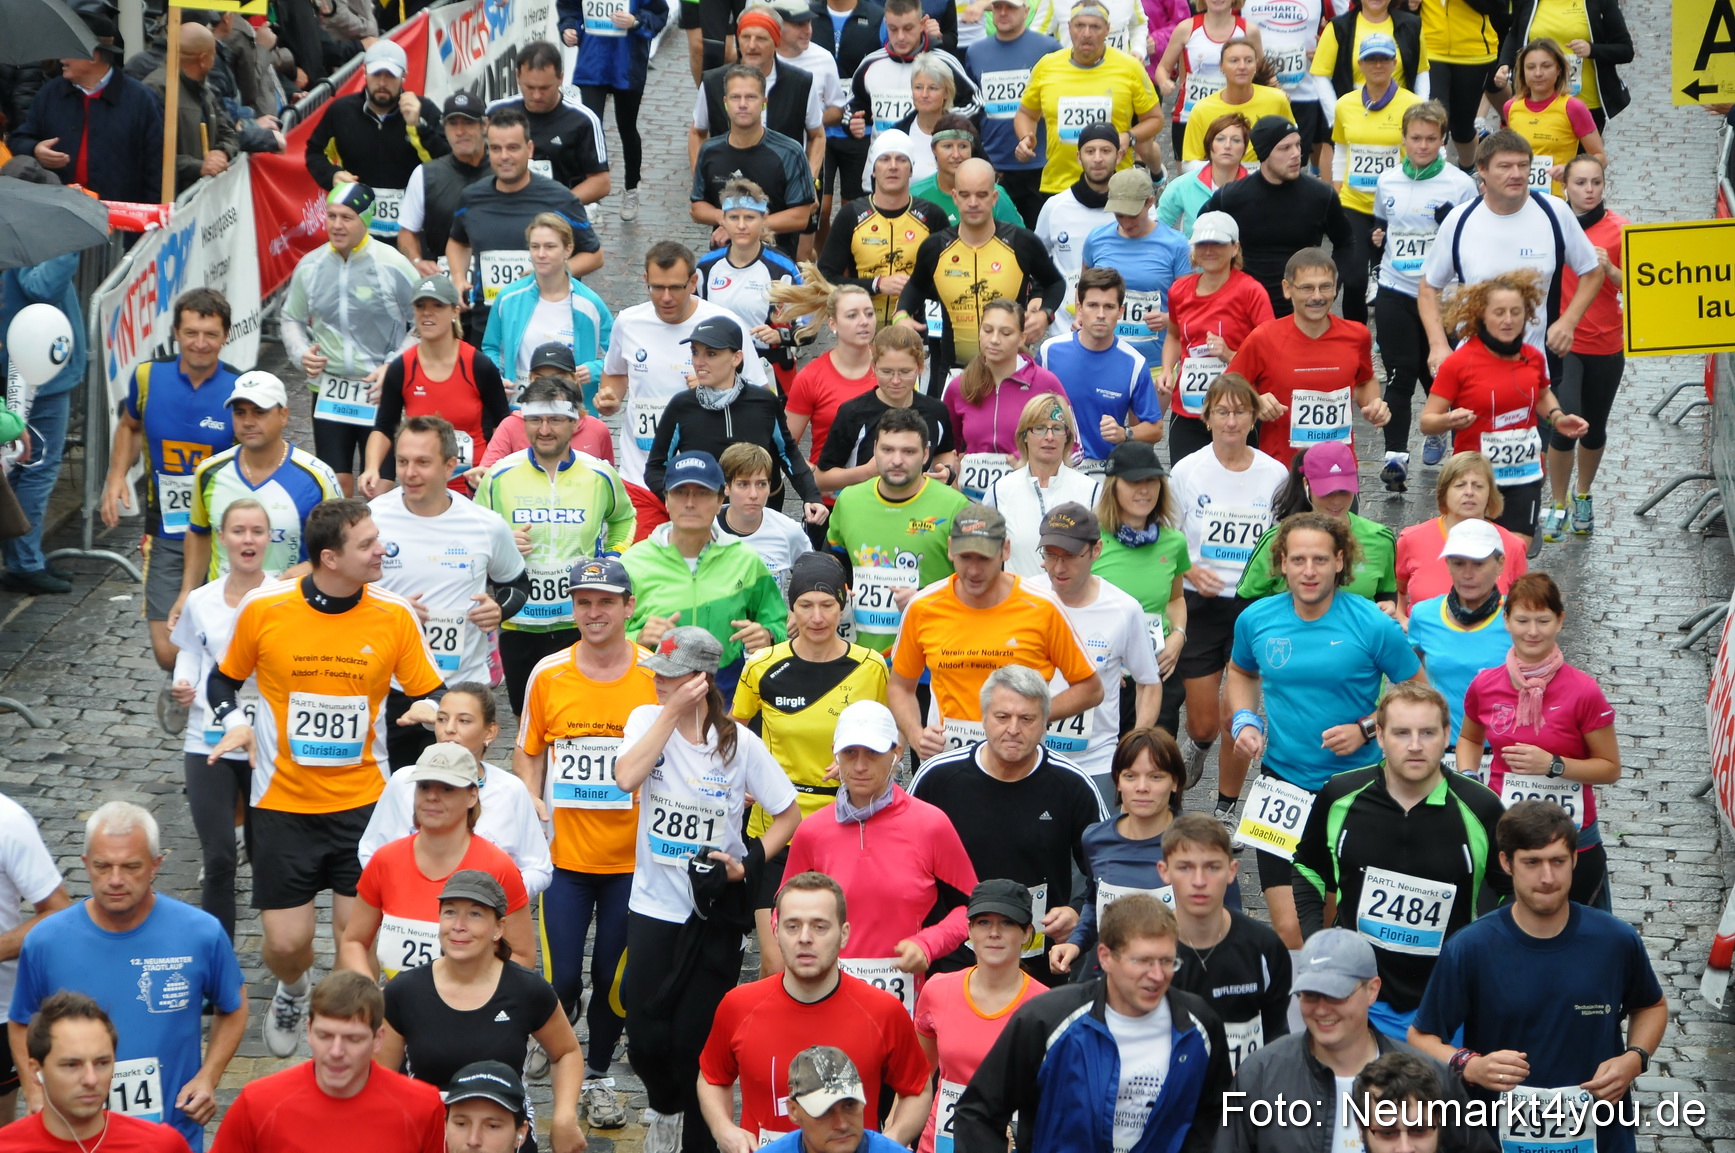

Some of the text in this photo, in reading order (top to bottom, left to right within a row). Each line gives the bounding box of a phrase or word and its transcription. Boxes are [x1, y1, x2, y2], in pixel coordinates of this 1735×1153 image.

[987, 82, 1026, 101] 2252
[875, 101, 913, 118] 2712
[1063, 108, 1107, 126] 2359
[1353, 155, 1395, 174] 2259
[1637, 261, 1735, 287] Schnu
[224, 310, 264, 350] eumarkt
[1119, 325, 1139, 336] Katja
[1293, 394, 1315, 402] PARTL
[332, 403, 359, 416] Fabian
[1298, 403, 1346, 426] 2687
[639, 413, 657, 435] 31
[1307, 429, 1338, 440] Richard
[1489, 442, 1536, 465] 2324
[981, 459, 1010, 467] Neumark
[514, 495, 561, 507] TEAM
[512, 507, 586, 524] BOCK
[1228, 512, 1260, 520] Neumarkt
[1208, 520, 1264, 545] 2679
[531, 568, 564, 577] Neumarkt
[854, 572, 906, 582] PARTL Neumarkt
[529, 576, 570, 602] 686
[523, 603, 563, 617] Gottfried
[869, 614, 896, 625] Oliver
[423, 626, 457, 652] 28
[982, 649, 1014, 657] Notärzte
[293, 654, 319, 662] Verein
[335, 655, 368, 667] Notärzte
[938, 661, 964, 669] Altdorf
[291, 669, 318, 677] Altdorf
[324, 669, 351, 678] Feucht
[291, 698, 356, 711] PARTL Neumarkt
[775, 696, 806, 708] Birgit
[295, 710, 358, 740] 2981
[567, 720, 590, 729] Verein
[592, 721, 605, 729] der
[945, 725, 969, 735] PARTL
[301, 742, 349, 757] Christian
[557, 743, 580, 751] PARTL
[1505, 779, 1569, 791] PARTL Neumarkt
[574, 787, 609, 799] Rainer
[1254, 780, 1309, 805] PARTL Neumarkt
[650, 793, 673, 808] PARTL
[1258, 795, 1302, 830] 139
[652, 807, 715, 842] 2881
[1249, 825, 1287, 846] Joachim
[1367, 874, 1440, 897] PARTL Neumarkt
[1367, 889, 1442, 927] 2484
[383, 923, 438, 938] PARTL Neumar
[1379, 926, 1420, 944] Florian
[130, 955, 193, 966] 12. NEUMARKTER
[402, 939, 433, 968] 25
[142, 963, 184, 972] STADTLAUF
[111, 1079, 152, 1112] 14
[942, 1088, 962, 1100] PART
[1115, 1110, 1149, 1121] umarkt
[1517, 1144, 1579, 1153] Ferdinand
